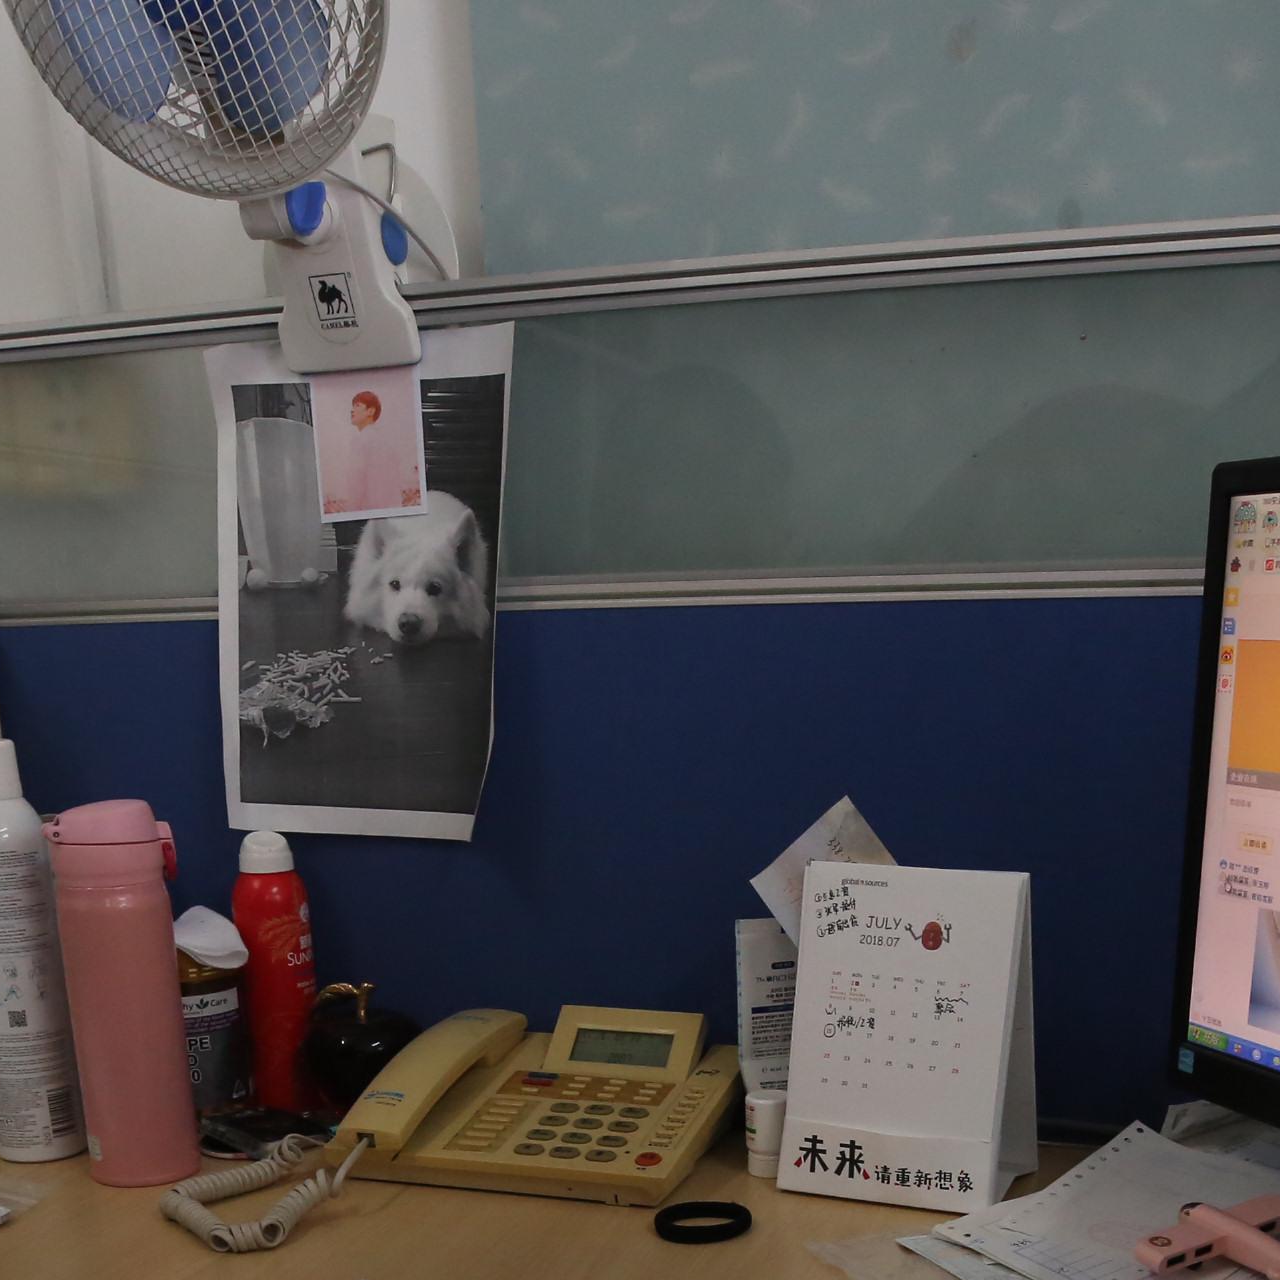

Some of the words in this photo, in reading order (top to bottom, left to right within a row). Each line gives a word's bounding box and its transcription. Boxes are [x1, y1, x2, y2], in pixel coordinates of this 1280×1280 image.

[866, 916, 902, 930] JULY
[859, 935, 901, 947] 2018.07
[794, 1134, 871, 1181] 未来
[874, 1164, 974, 1193] 请重新想象
